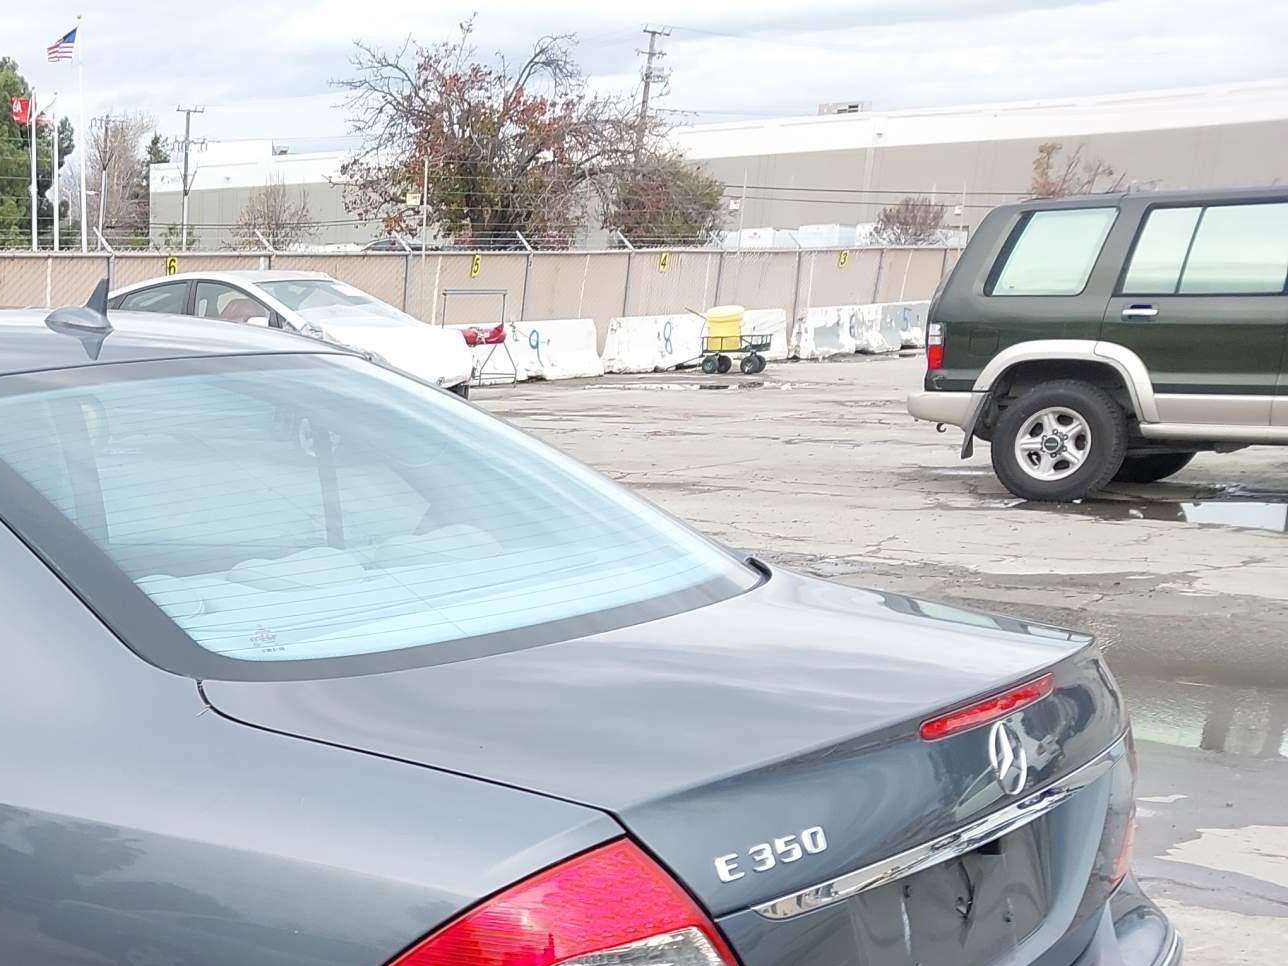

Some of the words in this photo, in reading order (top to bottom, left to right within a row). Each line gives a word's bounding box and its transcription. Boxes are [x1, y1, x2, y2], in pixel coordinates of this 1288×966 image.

[168, 258, 176, 275] 6
[473, 257, 480, 274] 5
[661, 254, 667, 269] 4
[842, 252, 848, 265] 3
[663, 321, 673, 355] 8
[528, 329, 545, 368] 9
[714, 852, 745, 883] E
[748, 825, 828, 873] 350
